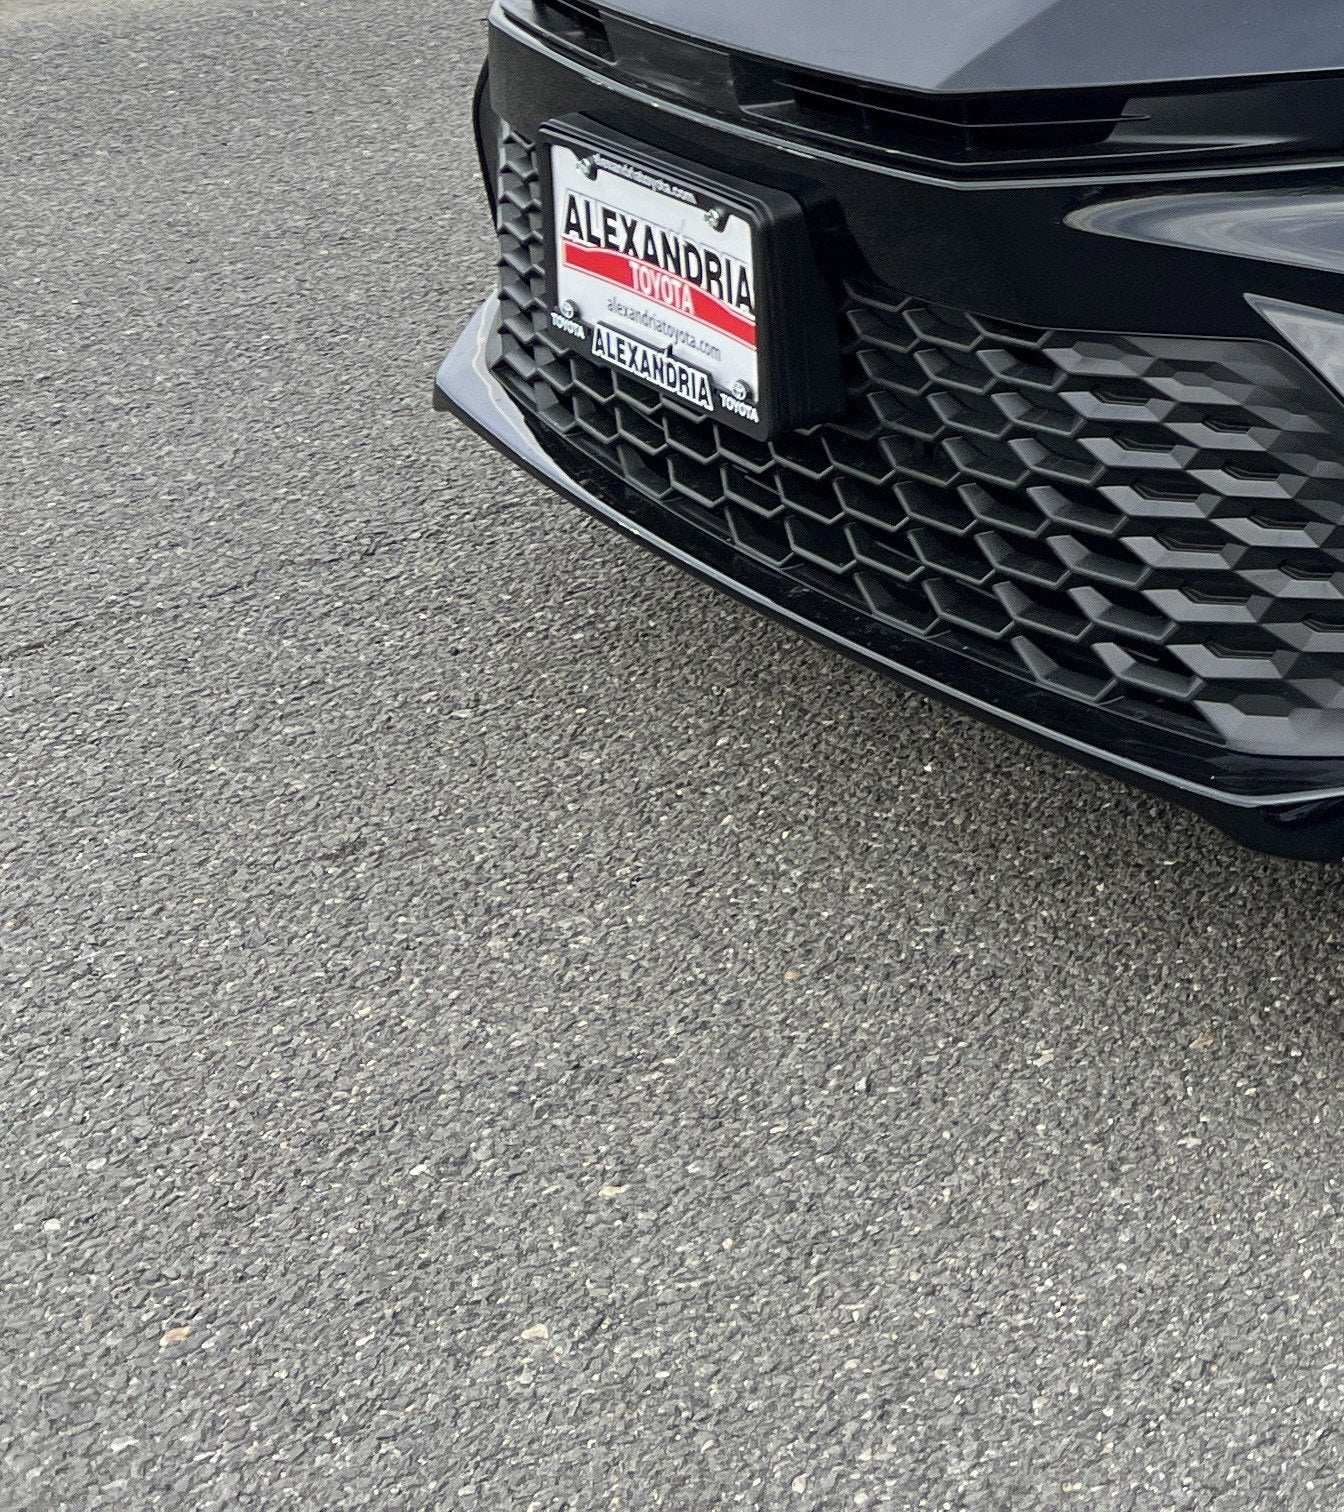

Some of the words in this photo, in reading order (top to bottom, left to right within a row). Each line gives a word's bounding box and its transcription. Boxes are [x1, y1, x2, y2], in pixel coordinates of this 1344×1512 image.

[564, 193, 756, 313] ALEXANDRIA
[629, 261, 696, 316] TOYOTA
[551, 312, 585, 339] TOYOTA
[594, 328, 711, 408] ALEXANDRIA
[720, 393, 759, 423] TOYOTA
